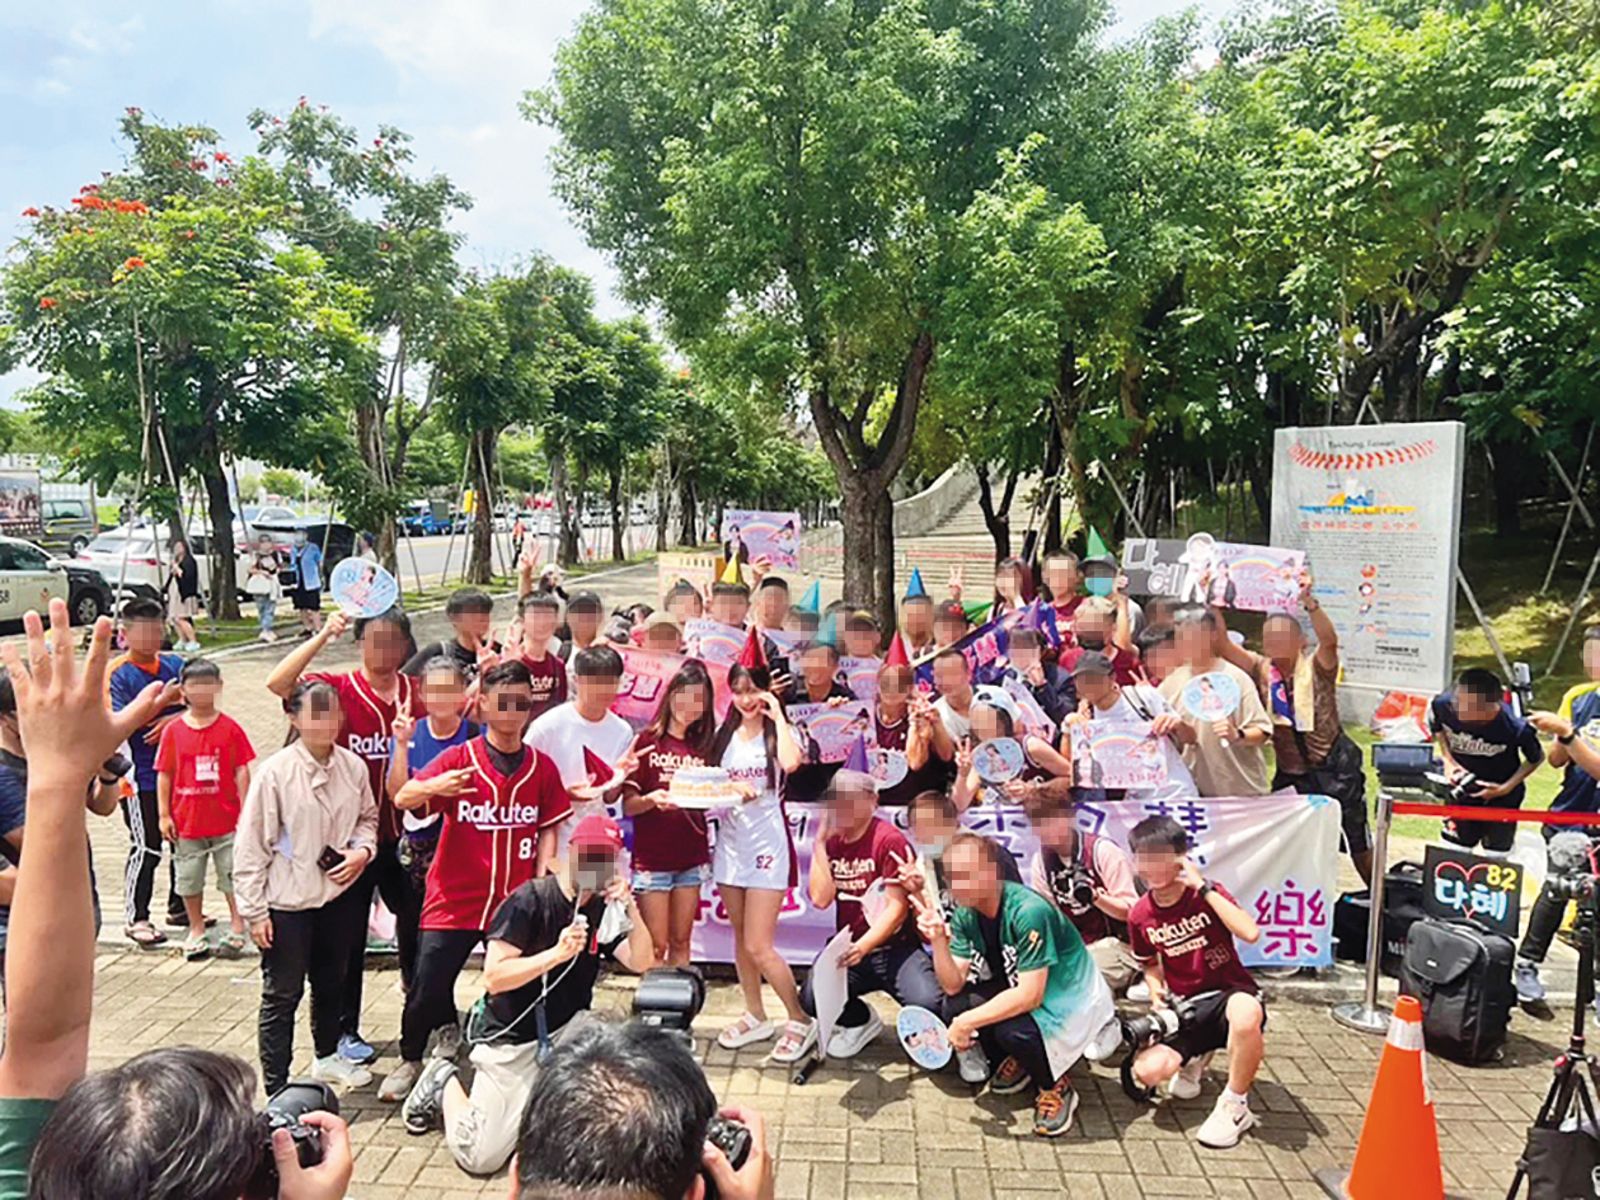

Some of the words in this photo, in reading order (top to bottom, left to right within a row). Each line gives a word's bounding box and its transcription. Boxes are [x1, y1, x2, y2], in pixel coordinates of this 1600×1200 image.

[756, 854, 774, 871] 82
[1486, 864, 1518, 891] 82
[1434, 878, 1507, 921] 다혜
[1146, 911, 1212, 946] Rakuten
[1254, 879, 1326, 958] 樂
